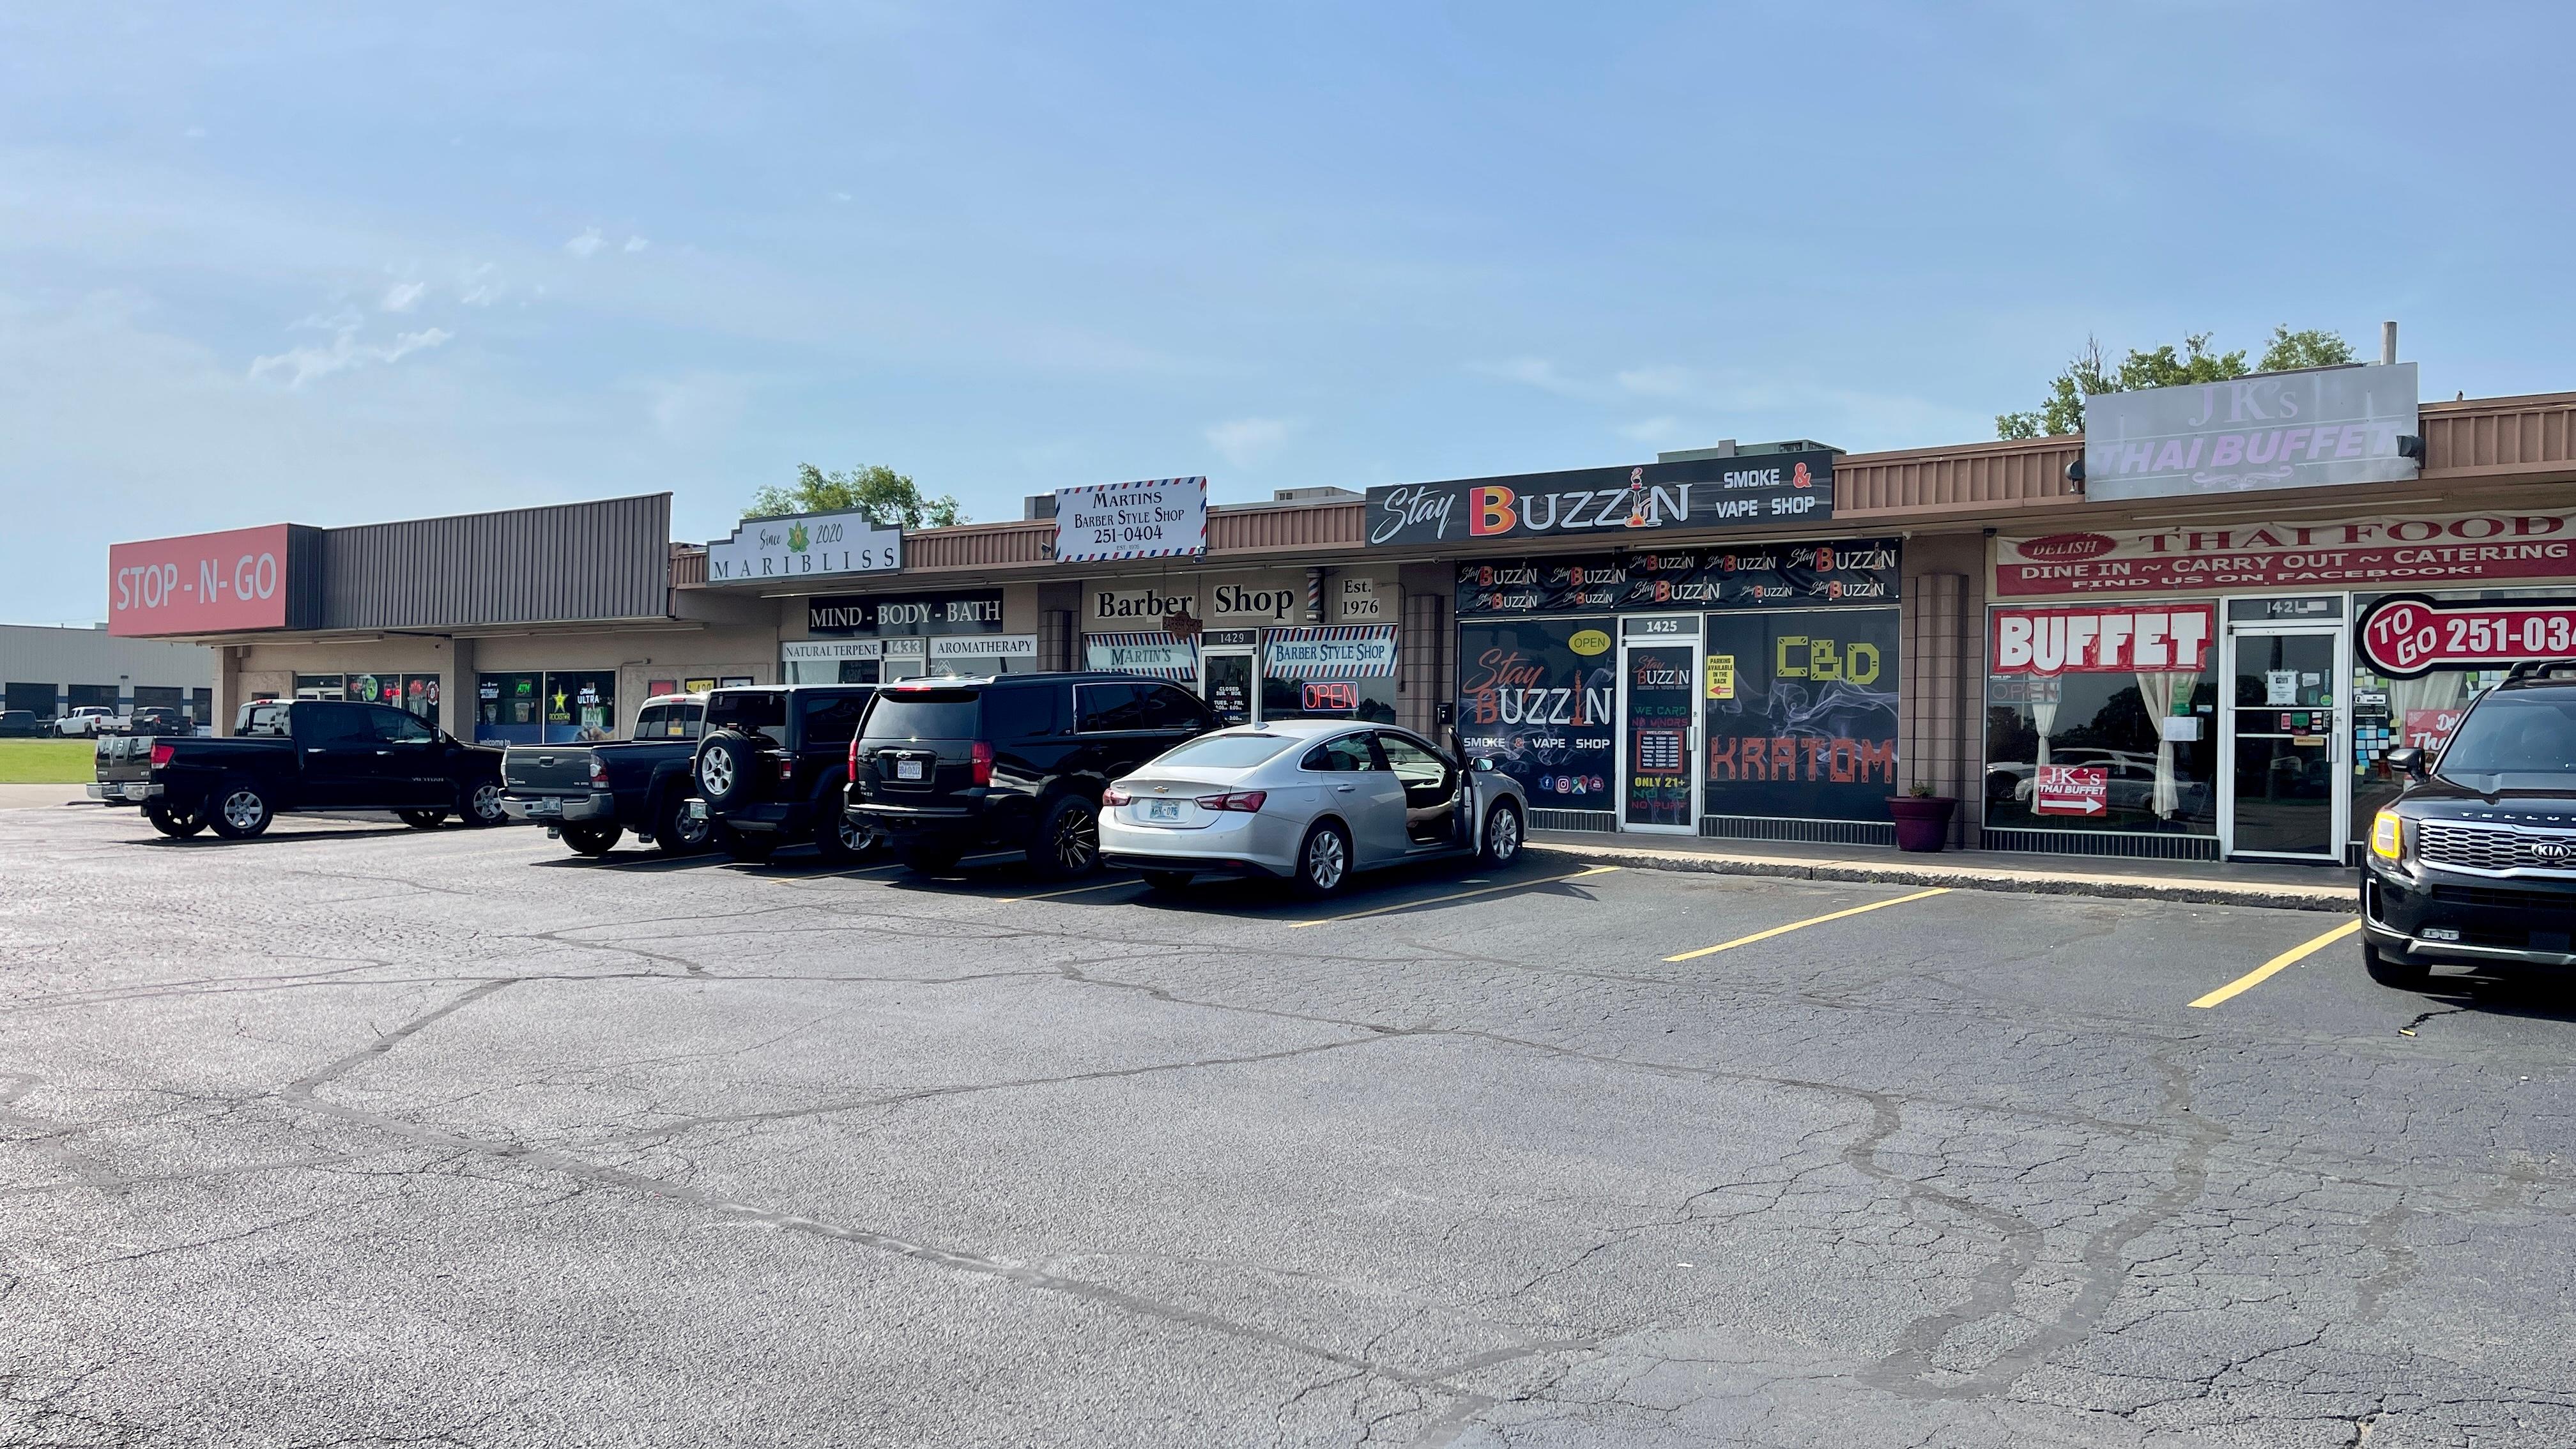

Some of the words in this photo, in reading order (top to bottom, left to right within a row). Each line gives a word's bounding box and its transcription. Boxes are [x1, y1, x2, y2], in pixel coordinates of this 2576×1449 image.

[2095, 438, 2206, 475] THAI
[2211, 422, 2402, 468] BUFFET
[1724, 468, 1780, 489] SMOKE
[1792, 461, 1812, 489] &
[1092, 491, 1162, 509] MARTINS
[1715, 499, 1758, 519] VAPE
[1771, 496, 1815, 516] SHOP
[1075, 513, 1114, 529] BARBER
[1118, 510, 1151, 525] STYLE
[1154, 509, 1184, 523] SHOP
[1371, 486, 1455, 544] Stay
[760, 529, 781, 550] Since
[816, 523, 843, 544] 2020
[1094, 525, 1163, 544] 251-0404
[2033, 539, 2098, 556] DELISH
[2139, 527, 2313, 553] THAI
[2341, 515, 2564, 546] FOOD
[1629, 555, 1648, 569] Stay
[1705, 555, 1725, 569] Stay
[1786, 548, 1817, 569] Stay
[2021, 565, 2091, 580] DINE
[2098, 564, 2131, 576] IN
[2174, 555, 2277, 573] CARRY
[2283, 553, 2349, 569] OUT
[2394, 542, 2568, 564] CATERING
[117, 563, 178, 610] STOP
[235, 553, 277, 601] GO
[1459, 567, 1480, 583] Stay
[1551, 567, 1570, 583] Stay
[2072, 578, 2150, 589] FIND
[2161, 575, 2207, 586] US
[2214, 573, 2263, 584] ON
[2270, 565, 2483, 581] FACEBOOK!
[1344, 579, 1372, 594] Est.
[1631, 581, 1657, 599] Stay
[1740, 585, 1755, 595] Stay
[1809, 582, 1830, 595] Stay
[1097, 590, 1193, 618] Barber
[1215, 584, 1294, 620] Shop
[1476, 592, 1494, 606] Stay
[1563, 592, 1577, 602] Stay
[810, 607, 862, 627] MIND
[877, 604, 931, 625] BODY
[946, 601, 1000, 623] BATH
[1342, 599, 1379, 615] 1976
[1646, 620, 1678, 632] 1425
[2375, 608, 2413, 645] TO
[1220, 633, 1245, 643] 1429
[1574, 637, 1606, 648] OPEN
[2000, 611, 2206, 671] BUFFET
[2446, 617, 2576, 654] 251-03
[786, 645, 831, 659] NATURAL
[833, 643, 878, 657] TERPENE
[888, 640, 921, 655] 1433
[937, 640, 1032, 654] AROMATHERAPY
[1276, 645, 1317, 661] BARBER
[1319, 645, 1353, 661] STYLE
[1358, 643, 1385, 659] SHOP
[2396, 625, 2437, 666] GO
[1111, 648, 1172, 665] MARTIN'S
[1632, 655, 1666, 675] Stay
[1777, 636, 1880, 685] CBD
[1462, 648, 1544, 702] Stay
[517, 683, 531, 693] ATM
[1305, 684, 1357, 708] OPEN
[1992, 682, 2058, 702] OPEN
[578, 695, 600, 703] ULTRA
[586, 710, 600, 720] TRY
[1635, 706, 1652, 715] WE
[1657, 706, 1687, 716] CARD
[480, 738, 503, 746] welcome
[504, 738, 511, 746] to
[1464, 737, 1505, 747] SMOKE
[1514, 737, 1524, 748] &
[1533, 738, 1565, 748] VAPE
[1575, 739, 1610, 749] SHOP
[1710, 737, 1892, 784] KRATOM
[1634, 777, 1661, 787] ONLY
[1665, 777, 1685, 788] 21+
[2039, 785, 2063, 793] THAI
[2065, 785, 2106, 795] BUFFET
[2538, 845, 2564, 857] KIA
